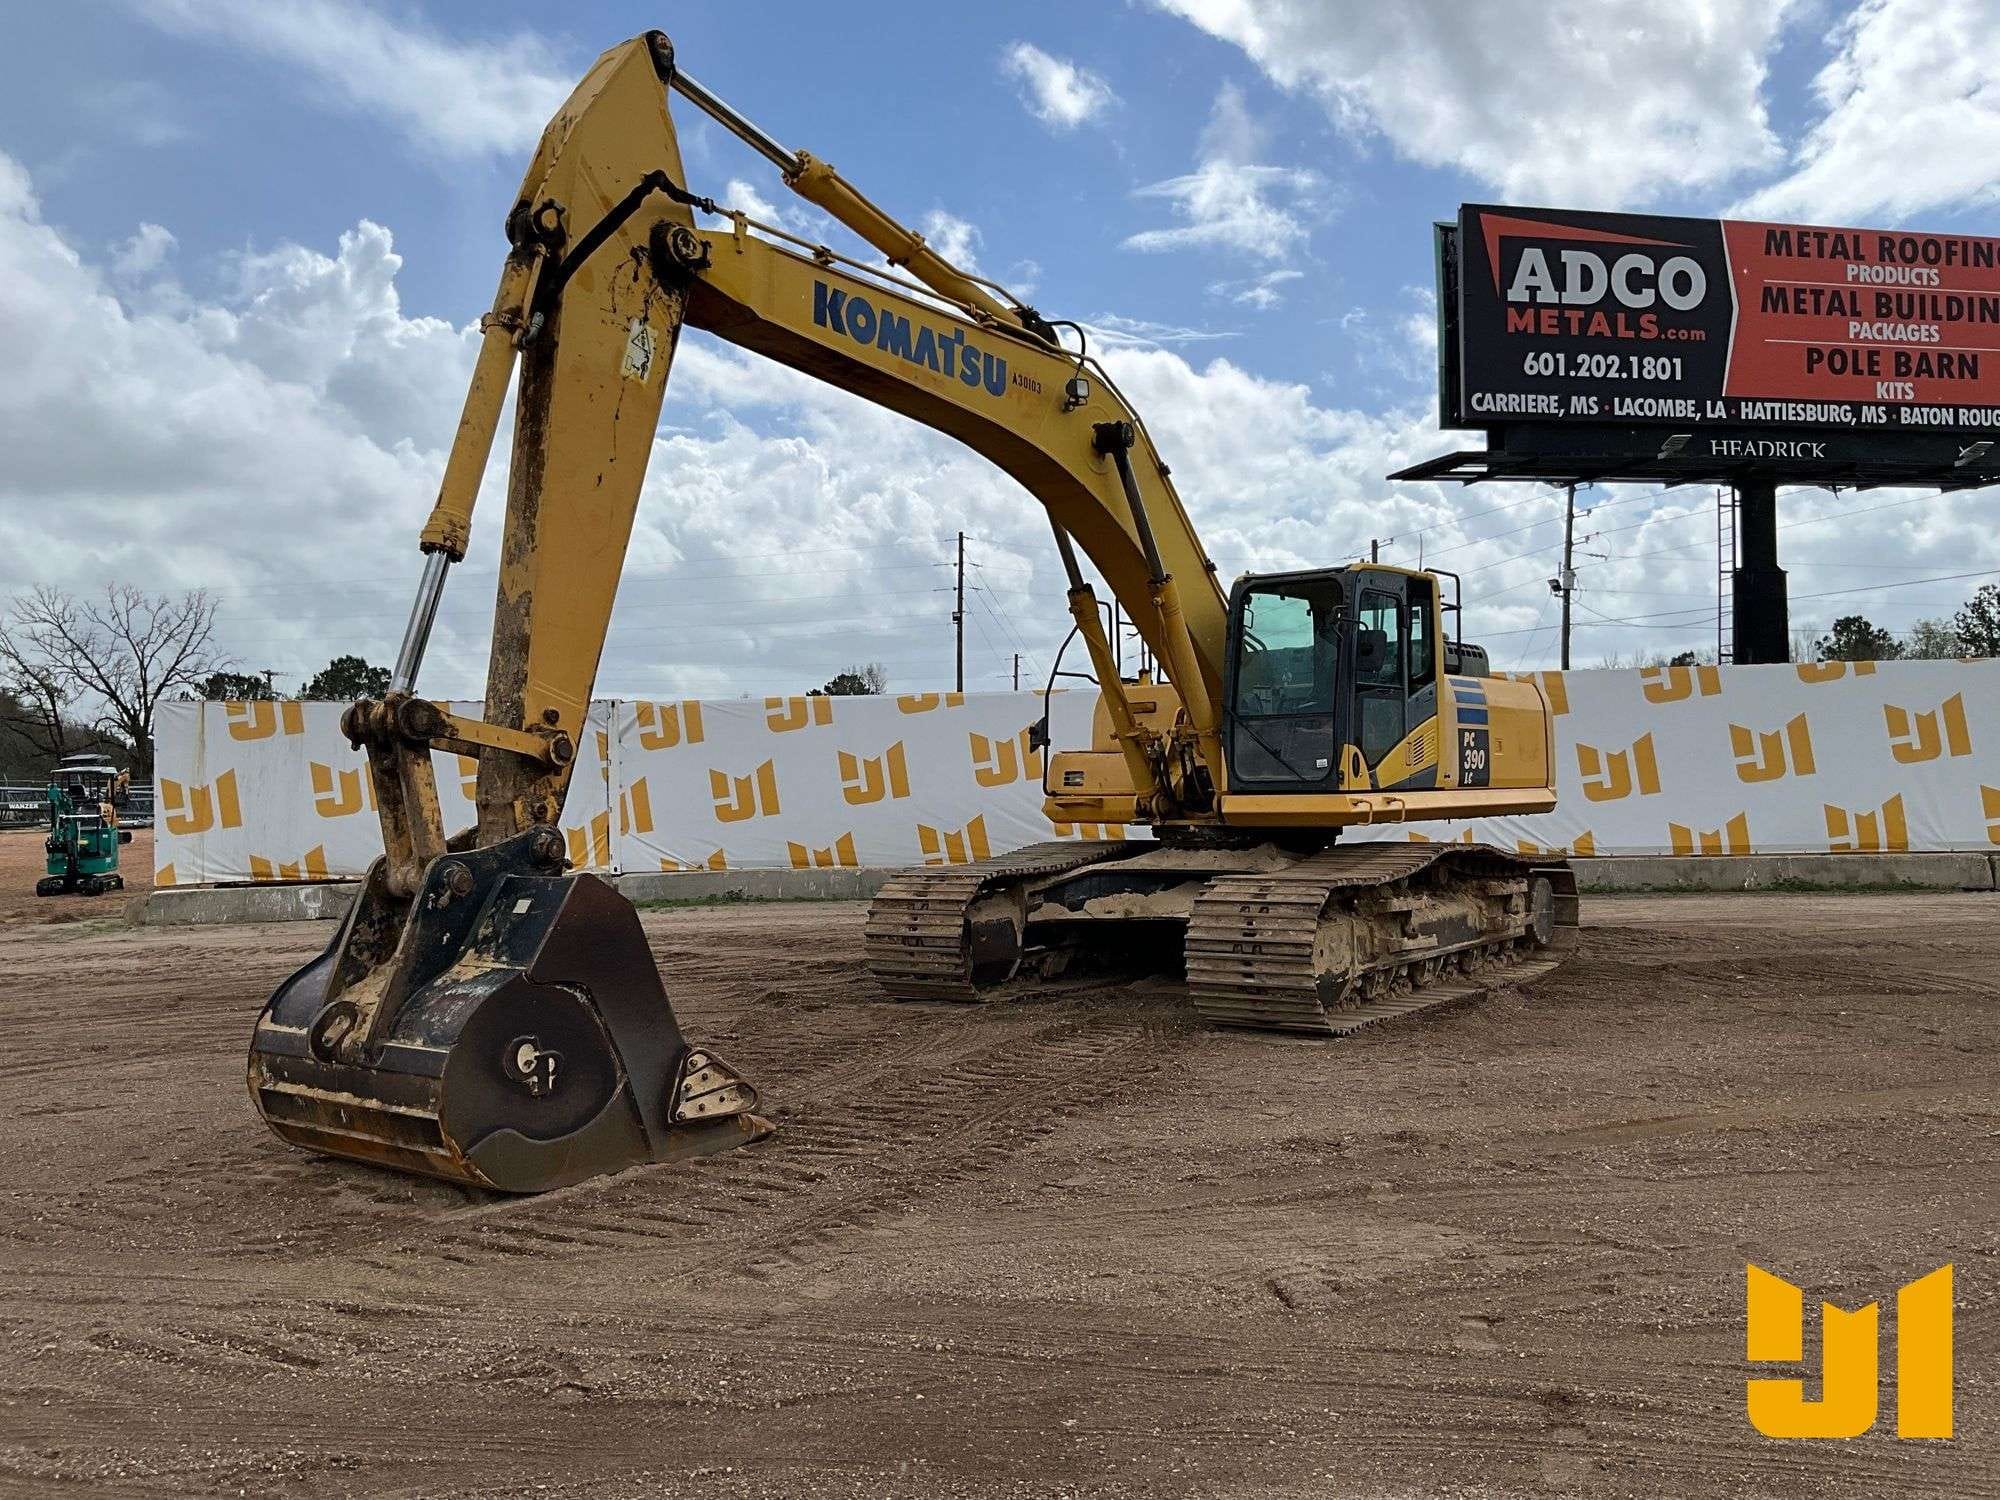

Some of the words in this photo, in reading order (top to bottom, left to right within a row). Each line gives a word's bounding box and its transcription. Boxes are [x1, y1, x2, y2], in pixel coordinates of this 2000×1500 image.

[1764, 229, 1865, 261] METAL
[1878, 235, 2000, 269] ROOFIN
[1507, 248, 1706, 311] ADCO
[1846, 264, 1940, 286] PRODUCTS
[1761, 286, 1862, 317] METAL
[813, 280, 1007, 397] KOMATSU
[1849, 321, 1940, 342] PACKAGES
[1524, 352, 1682, 380] 601.202.1801
[1807, 347, 1881, 376] POLE
[1895, 351, 1979, 379] BARN
[1876, 381, 1915, 400] KITS
[1471, 392, 1565, 417] CARRIERE,
[1570, 396, 1599, 415] MS
[1614, 397, 1701, 421] LACOMBE,
[1706, 401, 1727, 419] LA
[1741, 402, 1857, 426] HATTIESBURG,
[1861, 405, 1887, 424] MS
[1901, 407, 1953, 425] BATON
[1710, 439, 1827, 458] HEADRICK
[1464, 731, 1475, 747] PC
[1464, 749, 1485, 770] 390
